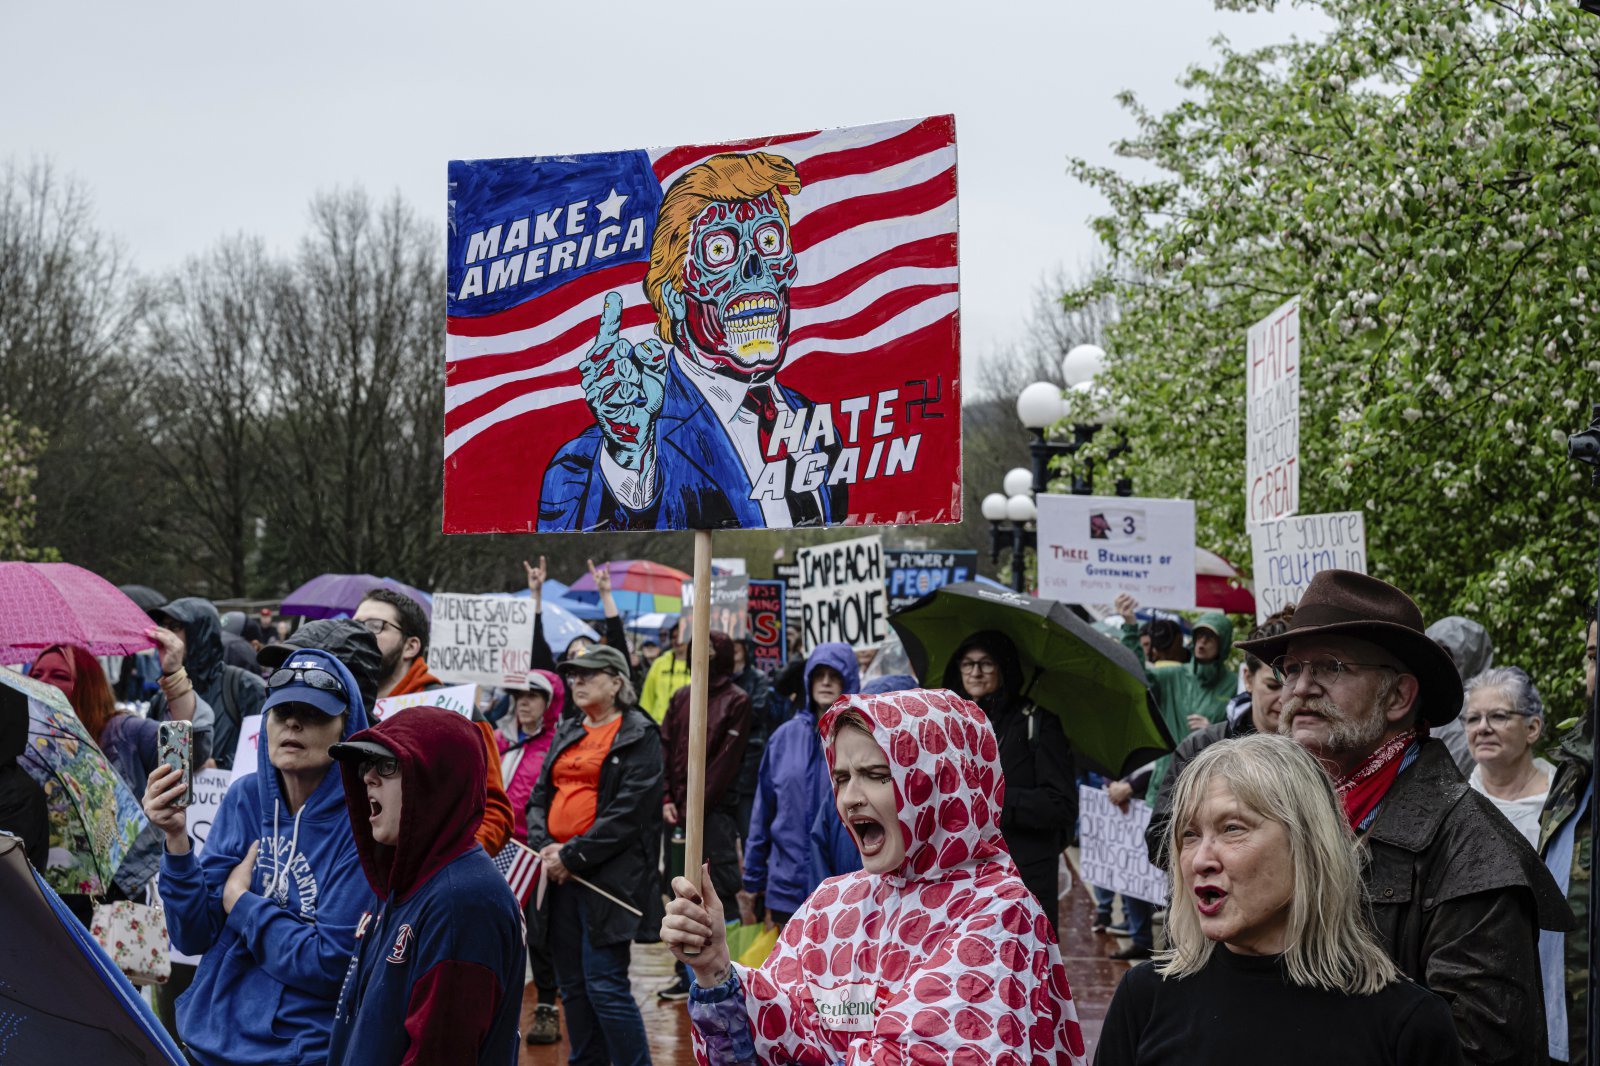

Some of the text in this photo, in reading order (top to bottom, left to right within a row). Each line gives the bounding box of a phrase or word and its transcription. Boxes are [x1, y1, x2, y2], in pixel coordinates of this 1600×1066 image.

[465, 199, 590, 266] MAKE
[456, 216, 645, 302] AMERICA
[1252, 307, 1297, 396] HATE
[766, 388, 900, 458] HATE
[748, 433, 923, 501] AGAIN
[1251, 416, 1298, 479] AMERICA
[1251, 457, 1296, 521] GREAT
[1122, 516, 1136, 535] 3
[1295, 517, 1325, 550] you
[1329, 514, 1359, 547] are
[801, 543, 881, 589] IMPEACH
[901, 553, 943, 568] POWER
[1050, 545, 1089, 560] THREE
[1098, 549, 1152, 565] BRANCHES
[1085, 564, 1149, 579] GOVERNMENT
[890, 567, 968, 597] PEOPLE
[433, 596, 527, 625] SCIENCE SAVES
[802, 590, 885, 652] REMOVE
[455, 624, 508, 648] LIVES
[502, 649, 530, 675] KILLS
